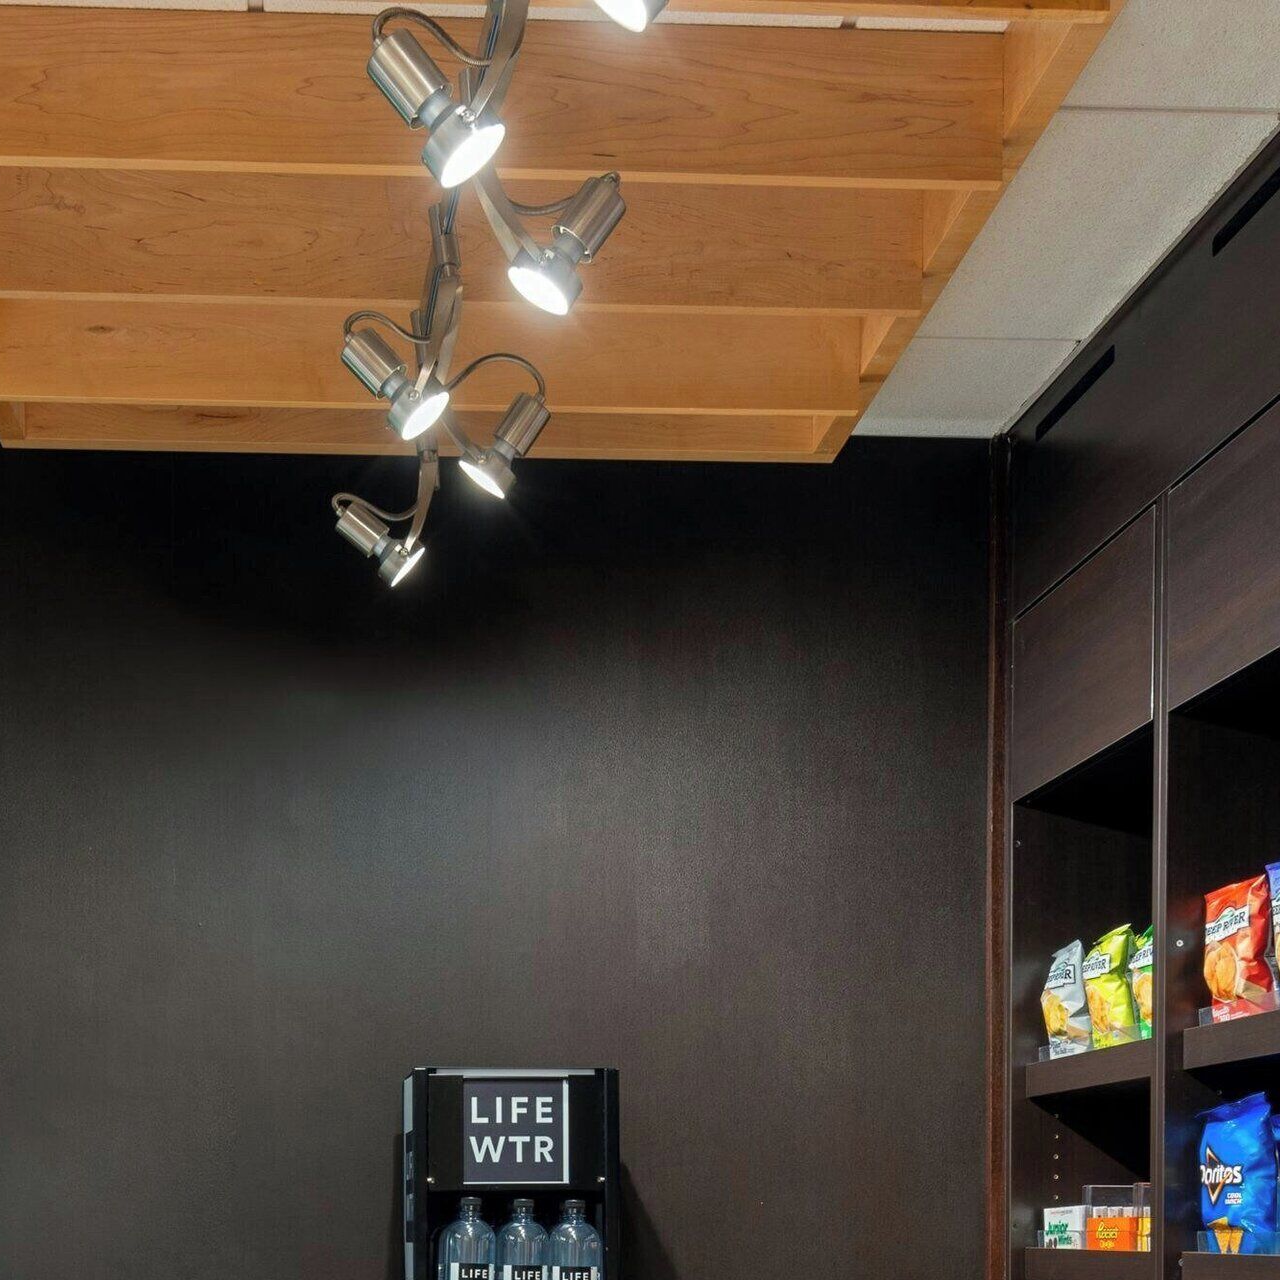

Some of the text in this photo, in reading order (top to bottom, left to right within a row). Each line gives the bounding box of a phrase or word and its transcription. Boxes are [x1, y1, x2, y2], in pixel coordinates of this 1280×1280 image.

[1223, 911, 1246, 932] RIVER
[471, 1096, 554, 1124] LIFE
[469, 1135, 555, 1163] WTR
[1045, 1220, 1070, 1237] Junior
[461, 1268, 489, 1279] LIFE
